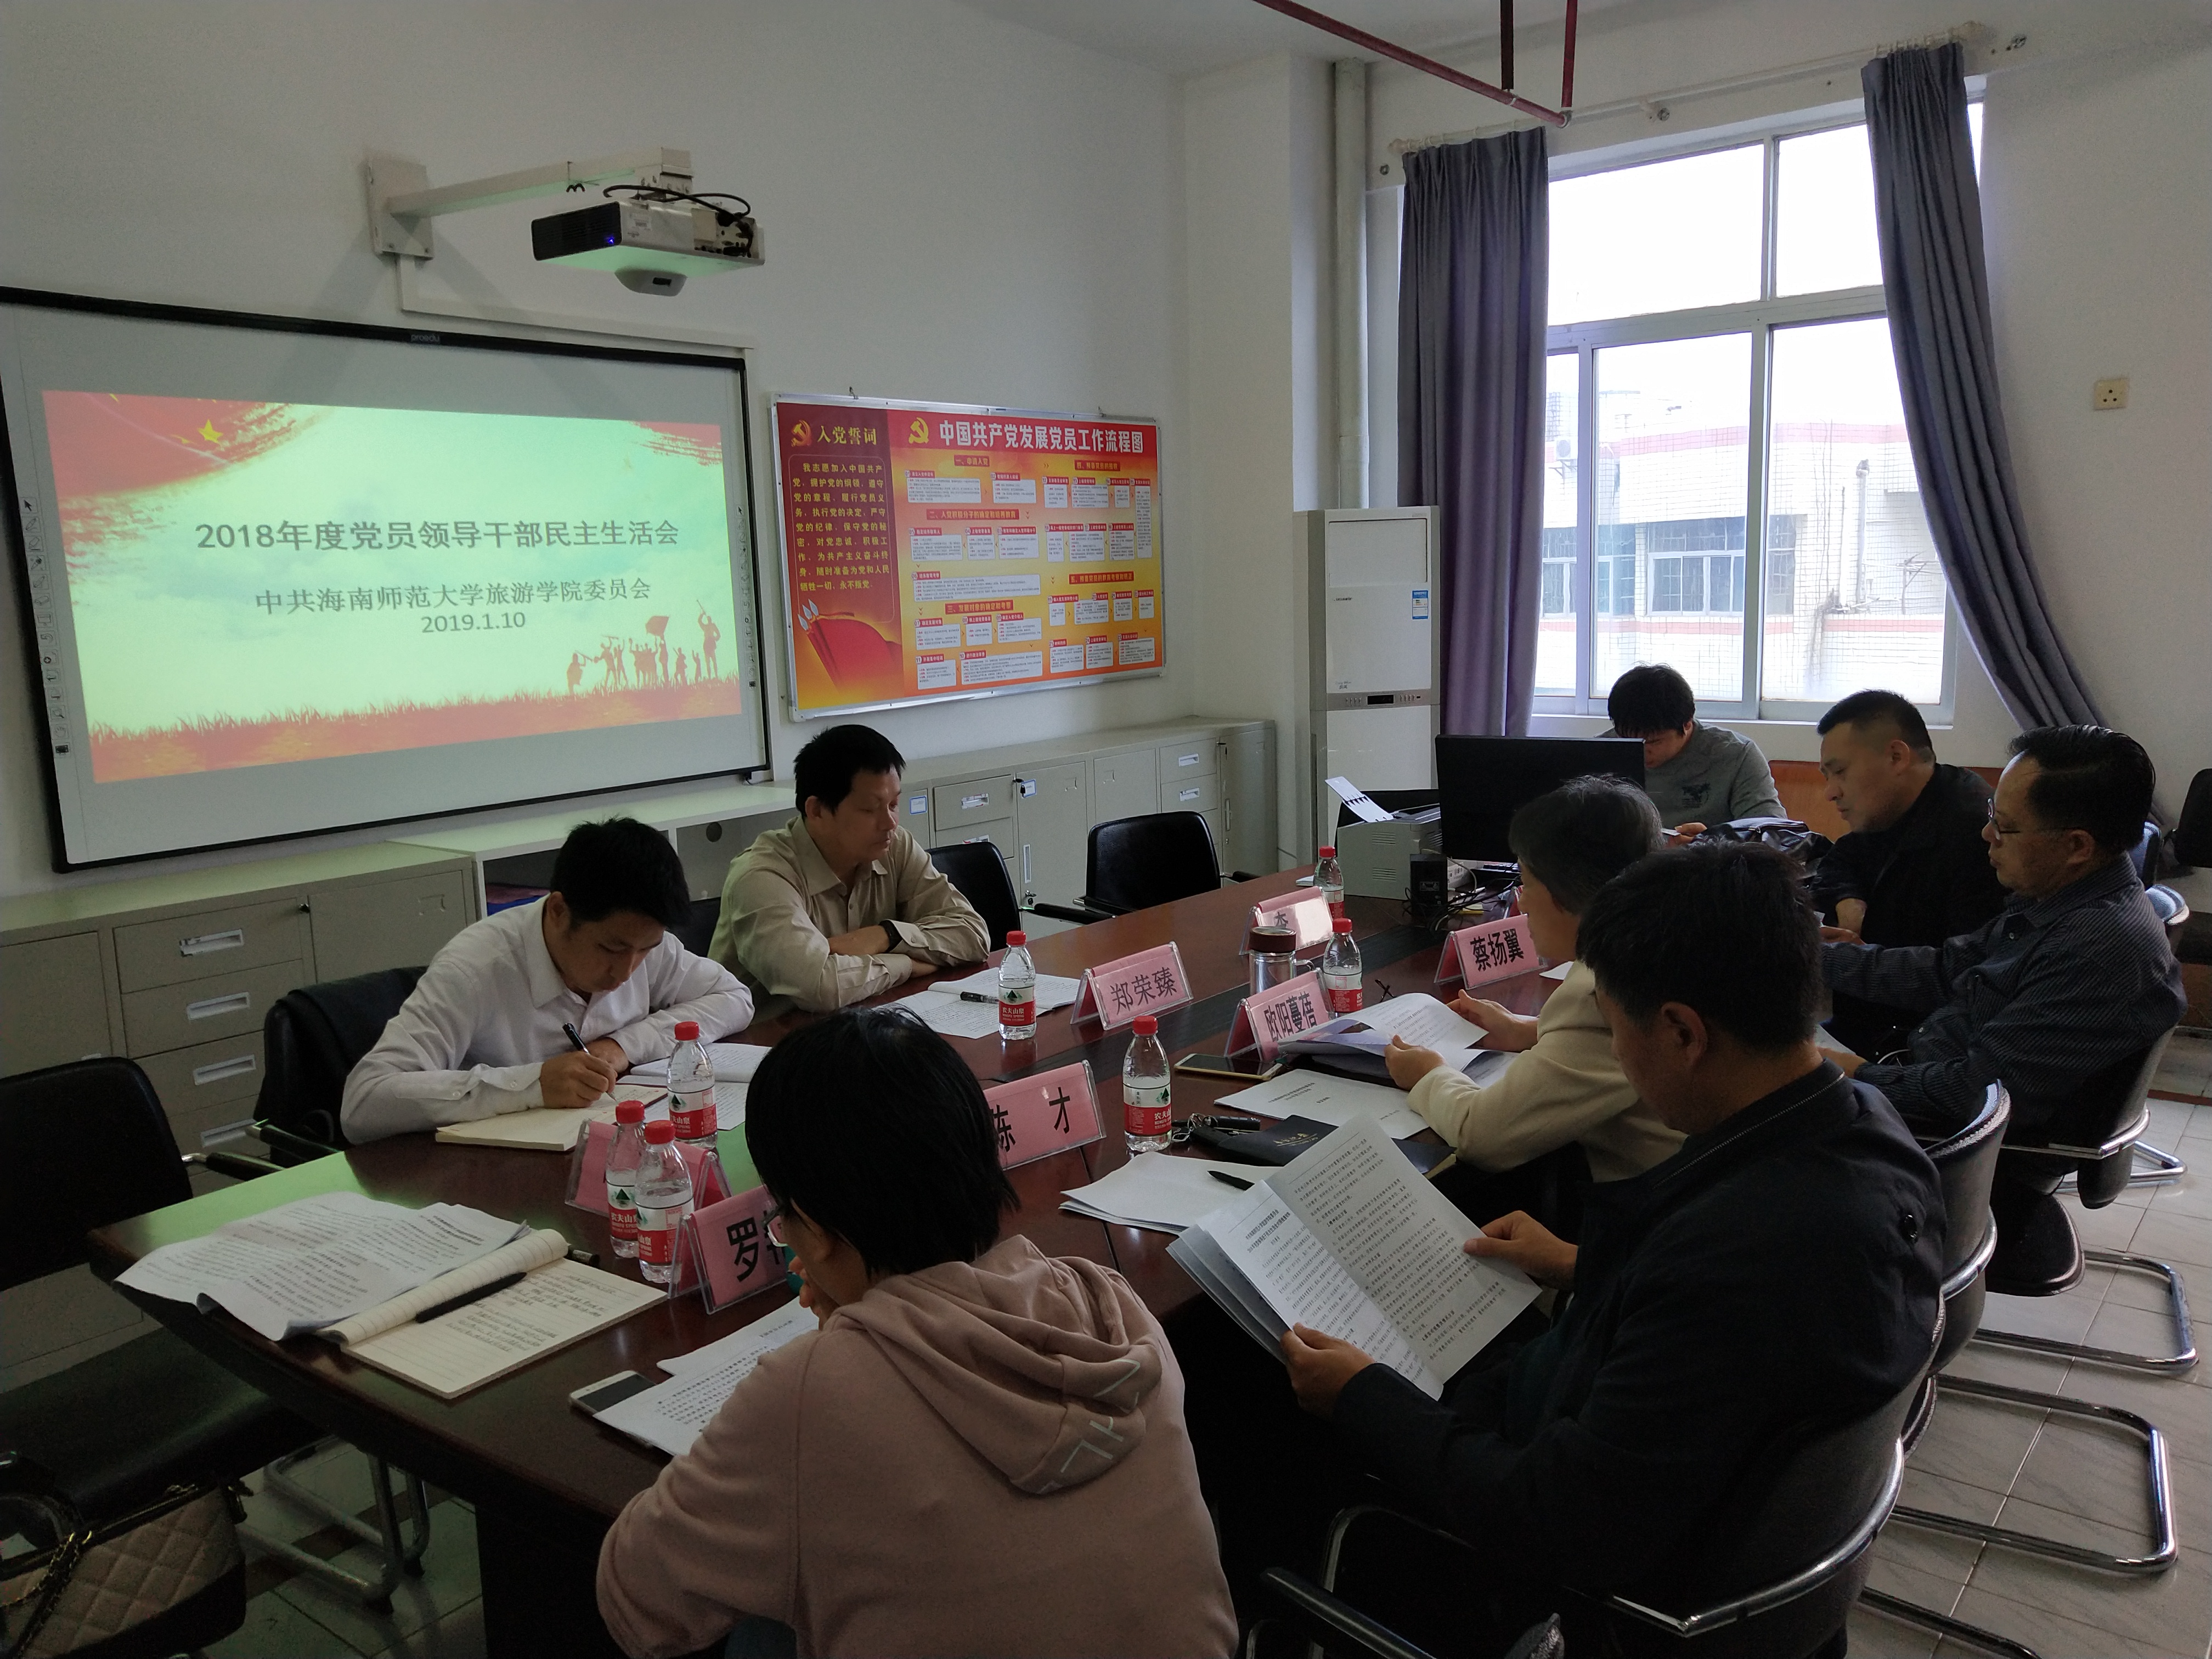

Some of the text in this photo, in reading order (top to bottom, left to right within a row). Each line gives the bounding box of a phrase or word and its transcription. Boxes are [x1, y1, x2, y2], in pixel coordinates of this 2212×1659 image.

[817, 426, 877, 445] 入党誓词
[939, 420, 1143, 453] 中国共产党发展党员工作流程图
[803, 463, 882, 473] 我志愿加入中国共产
[195, 520, 679, 551] 2018年度党员领导干部民主生活会
[256, 577, 651, 615] 中共海南师范大学旅游学院委员会
[421, 612, 526, 633] 2019.1.10
[1470, 928, 1524, 972] 蔡扬翼
[1109, 967, 1177, 1015] 郑荣臻
[1263, 991, 1318, 1042] 欧阳蔓蓓
